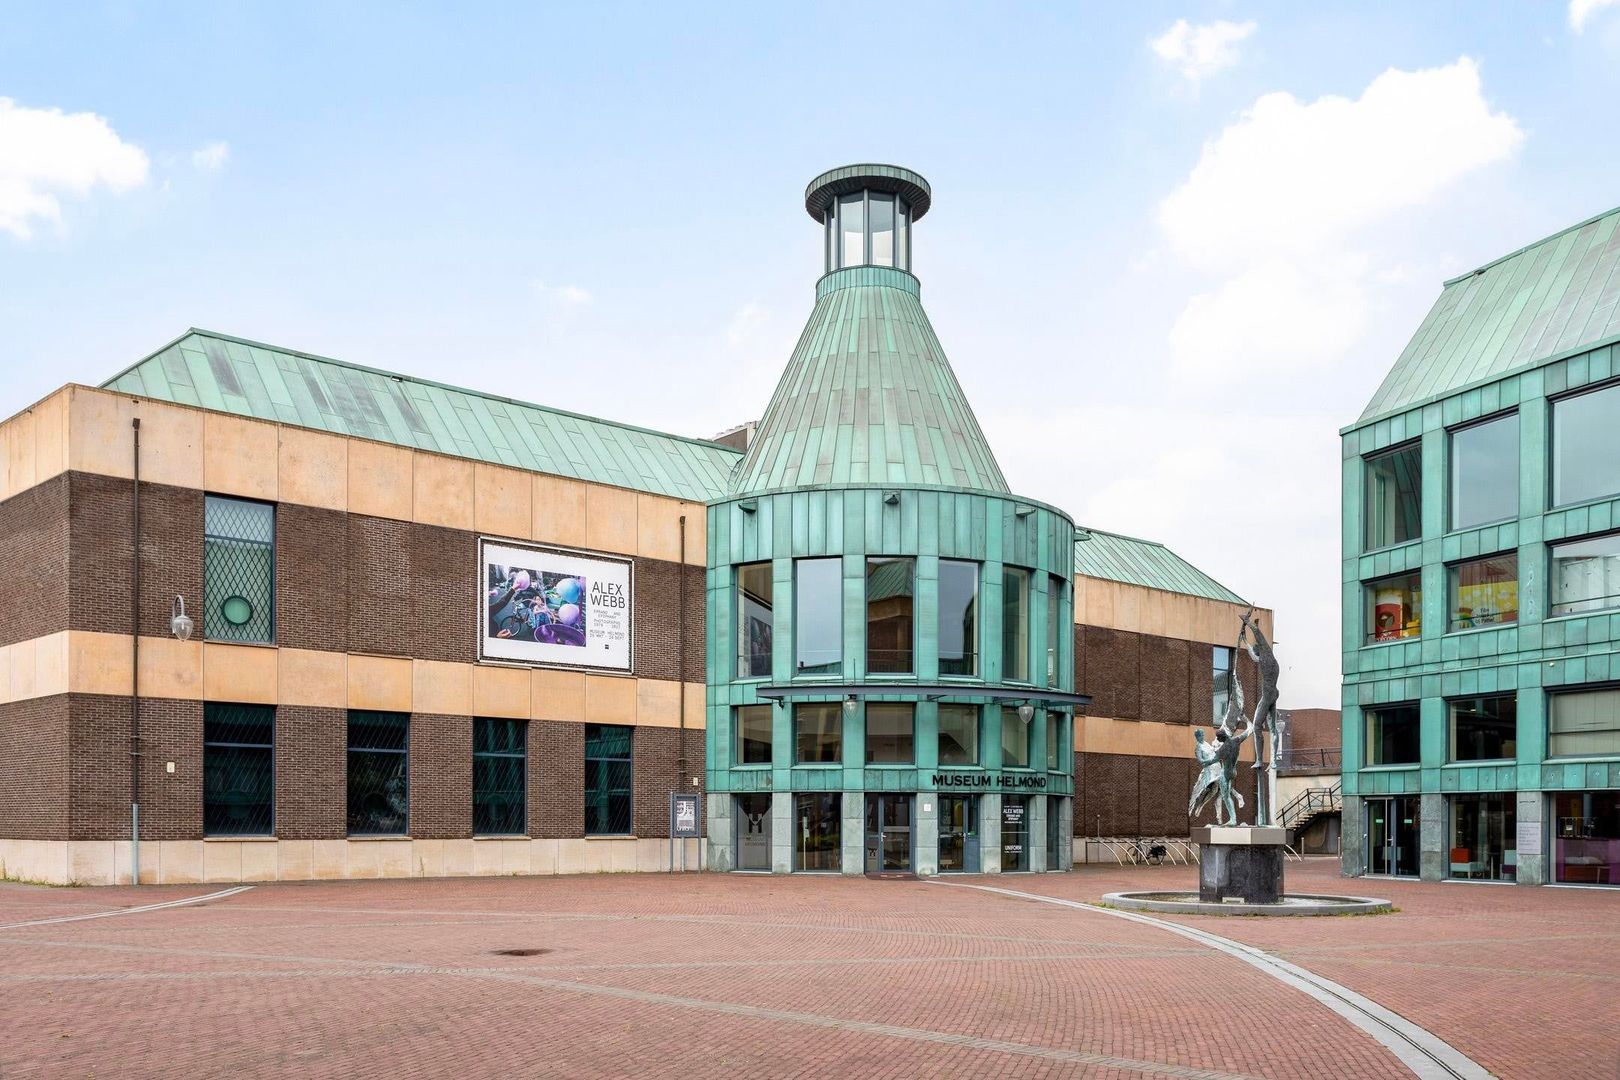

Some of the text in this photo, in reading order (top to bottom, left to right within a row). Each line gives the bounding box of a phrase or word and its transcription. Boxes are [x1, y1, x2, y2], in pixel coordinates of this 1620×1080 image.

[592, 581, 622, 596] ALEX
[590, 593, 626, 608] WEBB
[932, 775, 1047, 788] MUSEUM HELMOND
